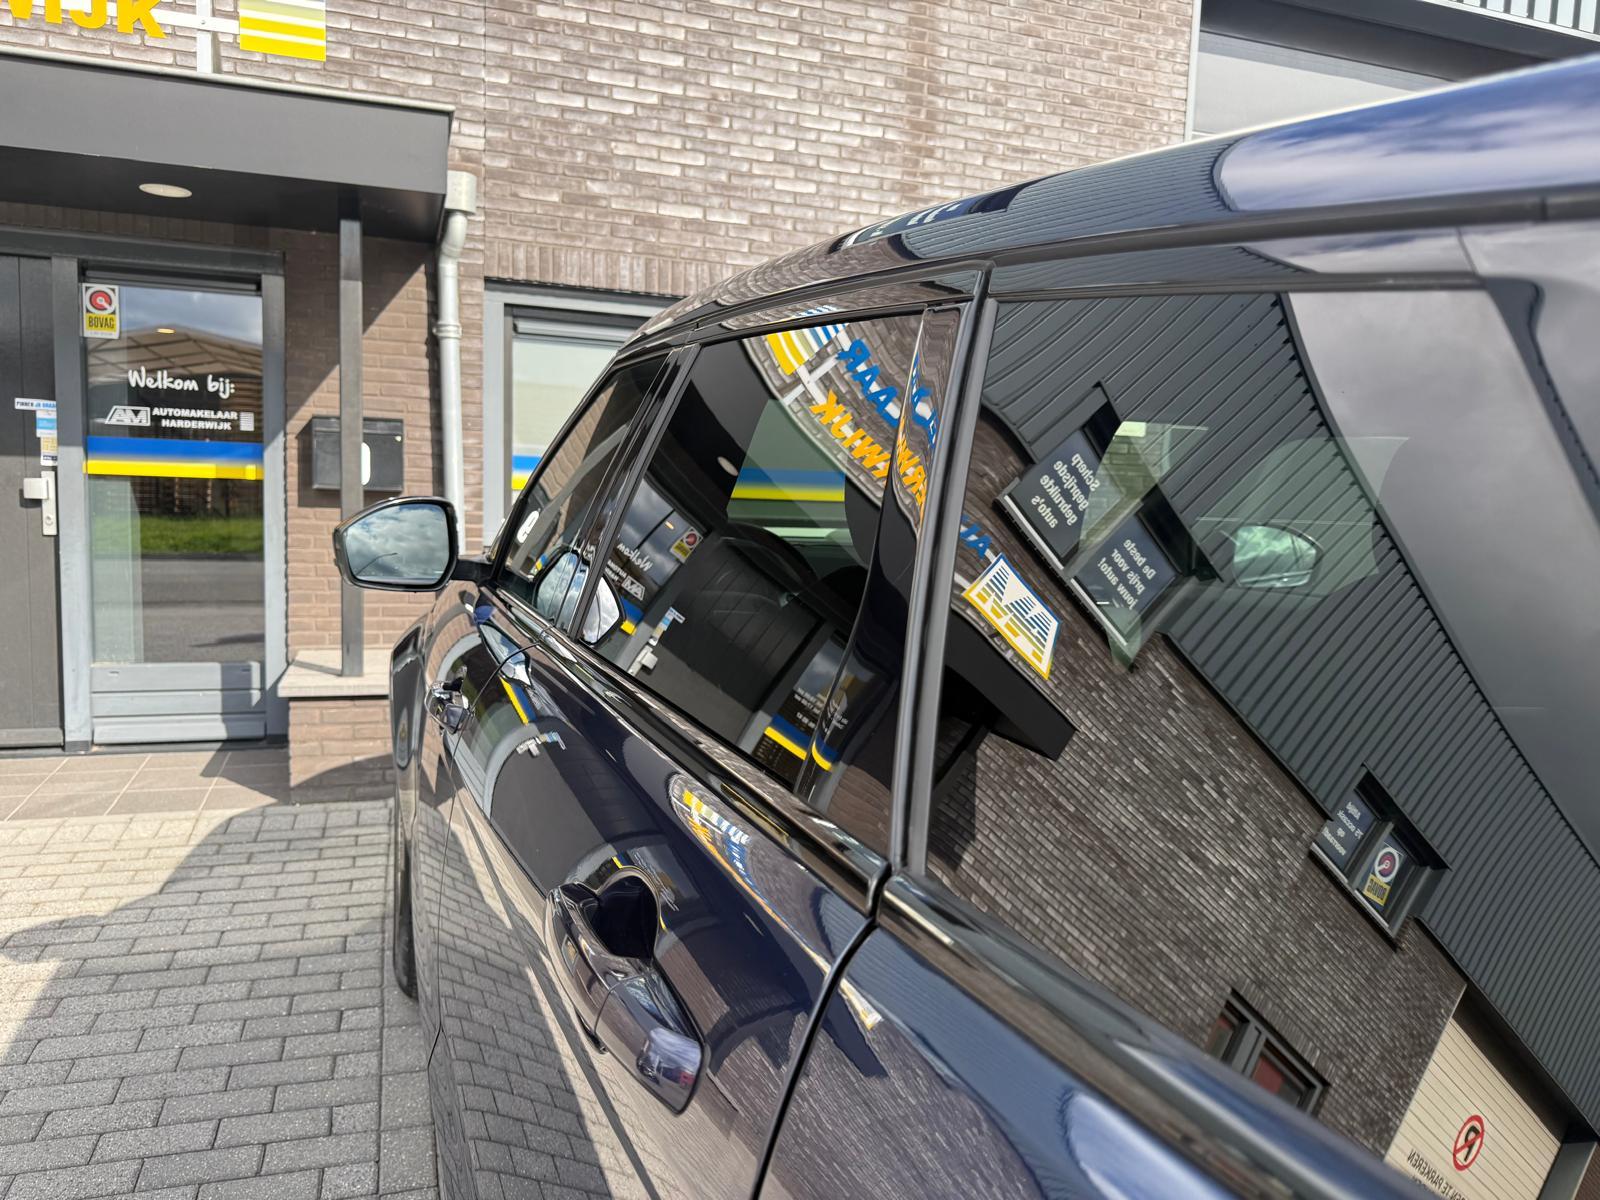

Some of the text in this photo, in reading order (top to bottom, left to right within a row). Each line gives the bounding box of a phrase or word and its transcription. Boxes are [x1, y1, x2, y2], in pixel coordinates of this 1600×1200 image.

[127, 365, 235, 399] Welkom bij:
[152, 407, 238, 420] AUTOMAKELAAR
[161, 418, 232, 431] HARDERWIJK
